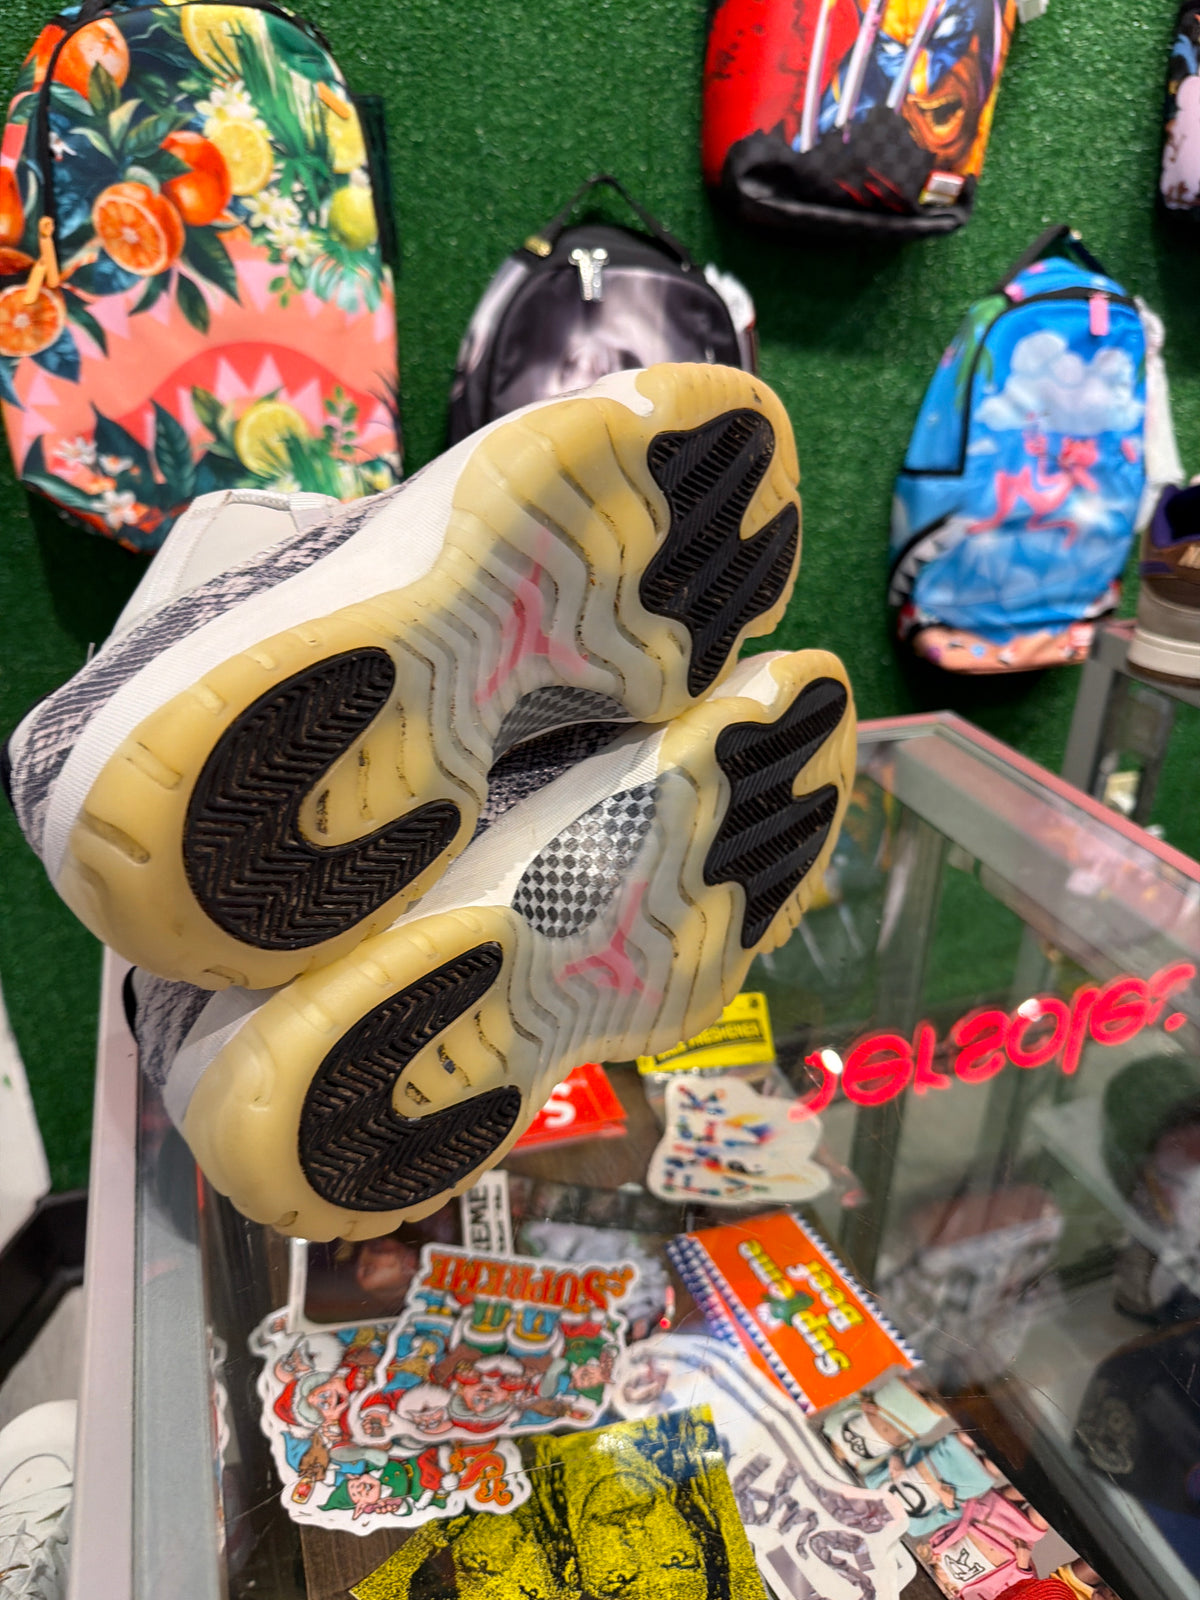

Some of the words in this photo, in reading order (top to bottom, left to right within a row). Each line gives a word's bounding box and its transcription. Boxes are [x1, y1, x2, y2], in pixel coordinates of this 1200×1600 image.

[468, 1184, 492, 1251] EME
[422, 1252, 634, 1314] SUPREME
[785, 1260, 865, 1334] Beef
